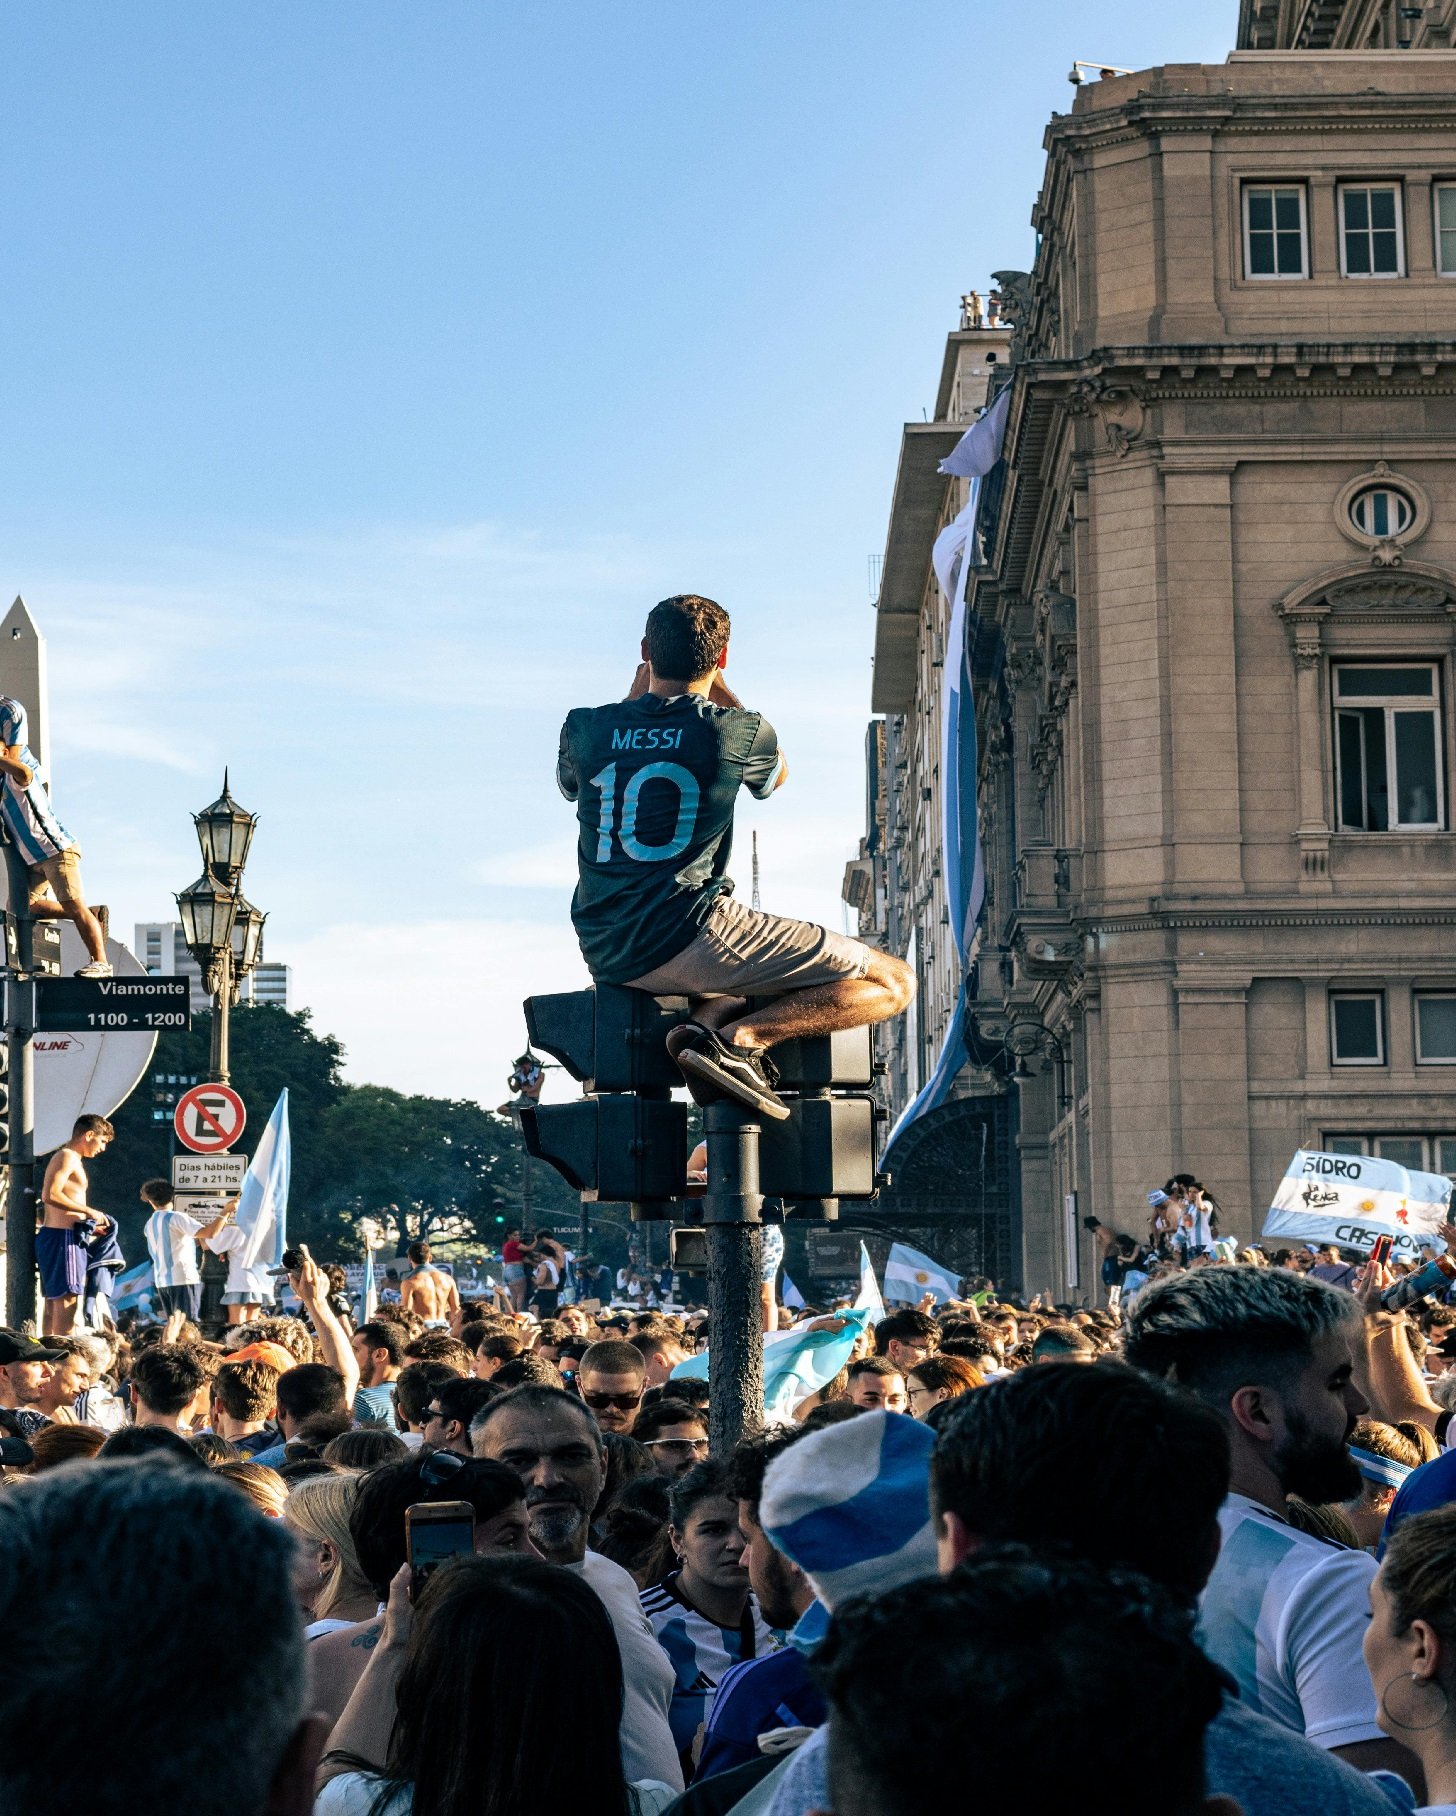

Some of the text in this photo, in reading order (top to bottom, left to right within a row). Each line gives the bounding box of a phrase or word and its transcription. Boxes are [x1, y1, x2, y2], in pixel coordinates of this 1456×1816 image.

[611, 728, 683, 750] MESSI
[589, 761, 701, 863] 10
[98, 981, 185, 994] Viamonte
[87, 1013, 128, 1026] 1100
[144, 1013, 185, 1026] 1200
[204, 1162, 241, 1171] hábiles
[178, 1175, 191, 1184] de
[193, 1175, 199, 1183] 7
[210, 1175, 221, 1183] 21
